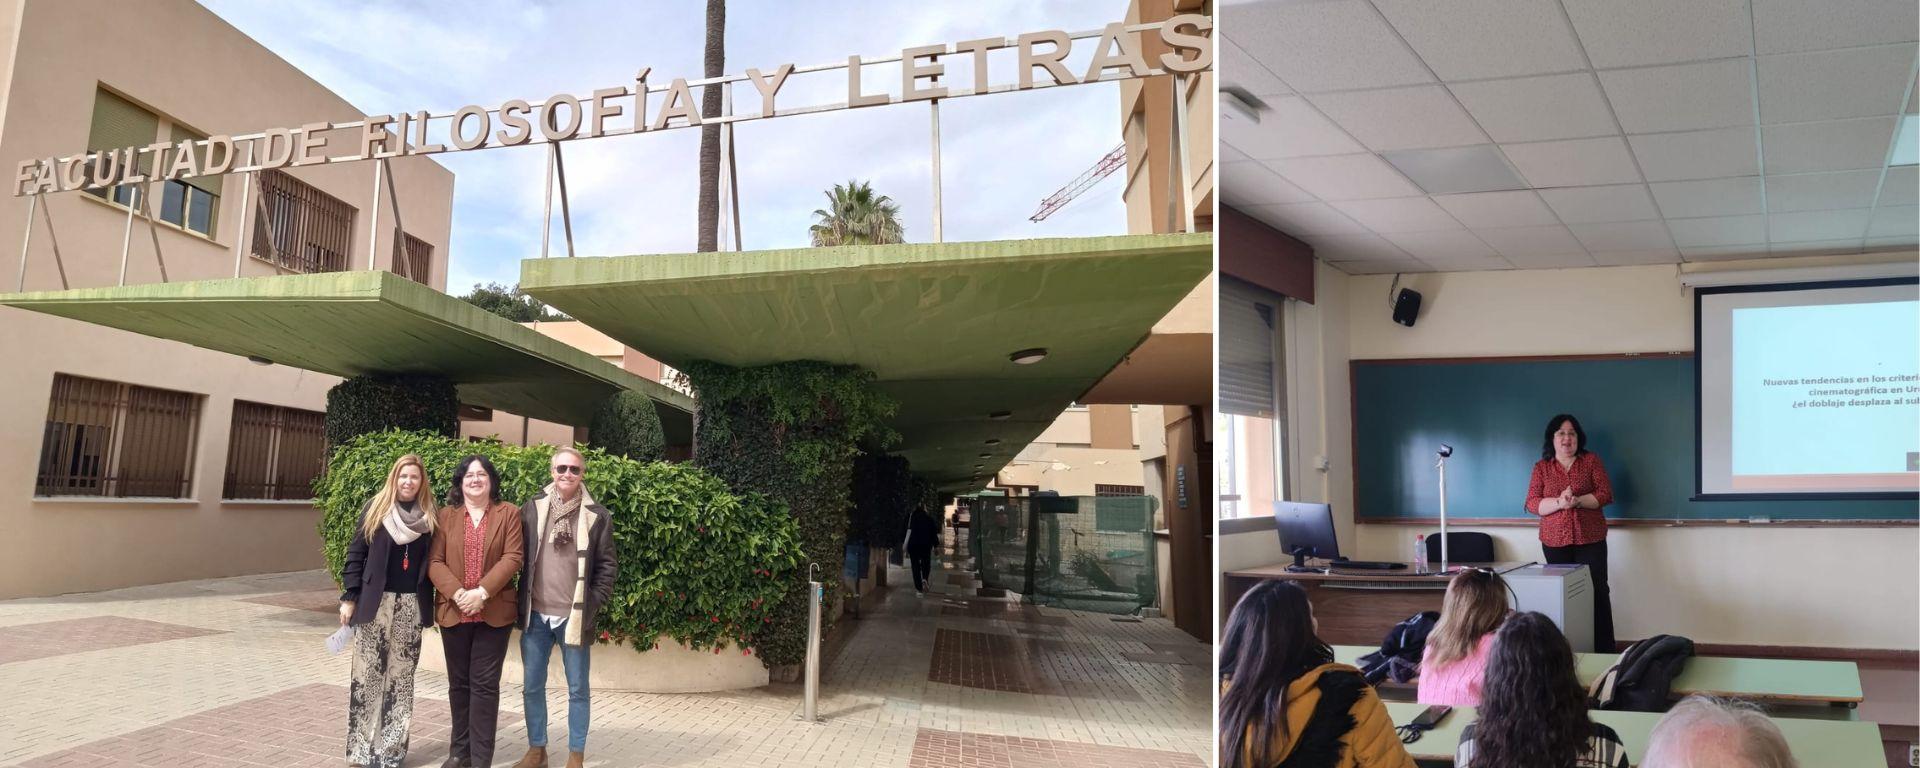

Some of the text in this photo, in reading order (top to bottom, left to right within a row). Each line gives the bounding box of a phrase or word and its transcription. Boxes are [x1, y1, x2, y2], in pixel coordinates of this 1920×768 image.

[13, 13, 1213, 197] FACULTAD DE FILOSOFÍA Y LETRAS
[1801, 376, 1854, 385] tendencias
[1872, 375, 1886, 383] los
[1888, 373, 1919, 382] criteri
[1808, 386, 1888, 396] cinematográfica
[1792, 400, 1807, 409] ¿el
[1808, 399, 1845, 408] doblaje
[1848, 398, 1891, 407] desplaza
